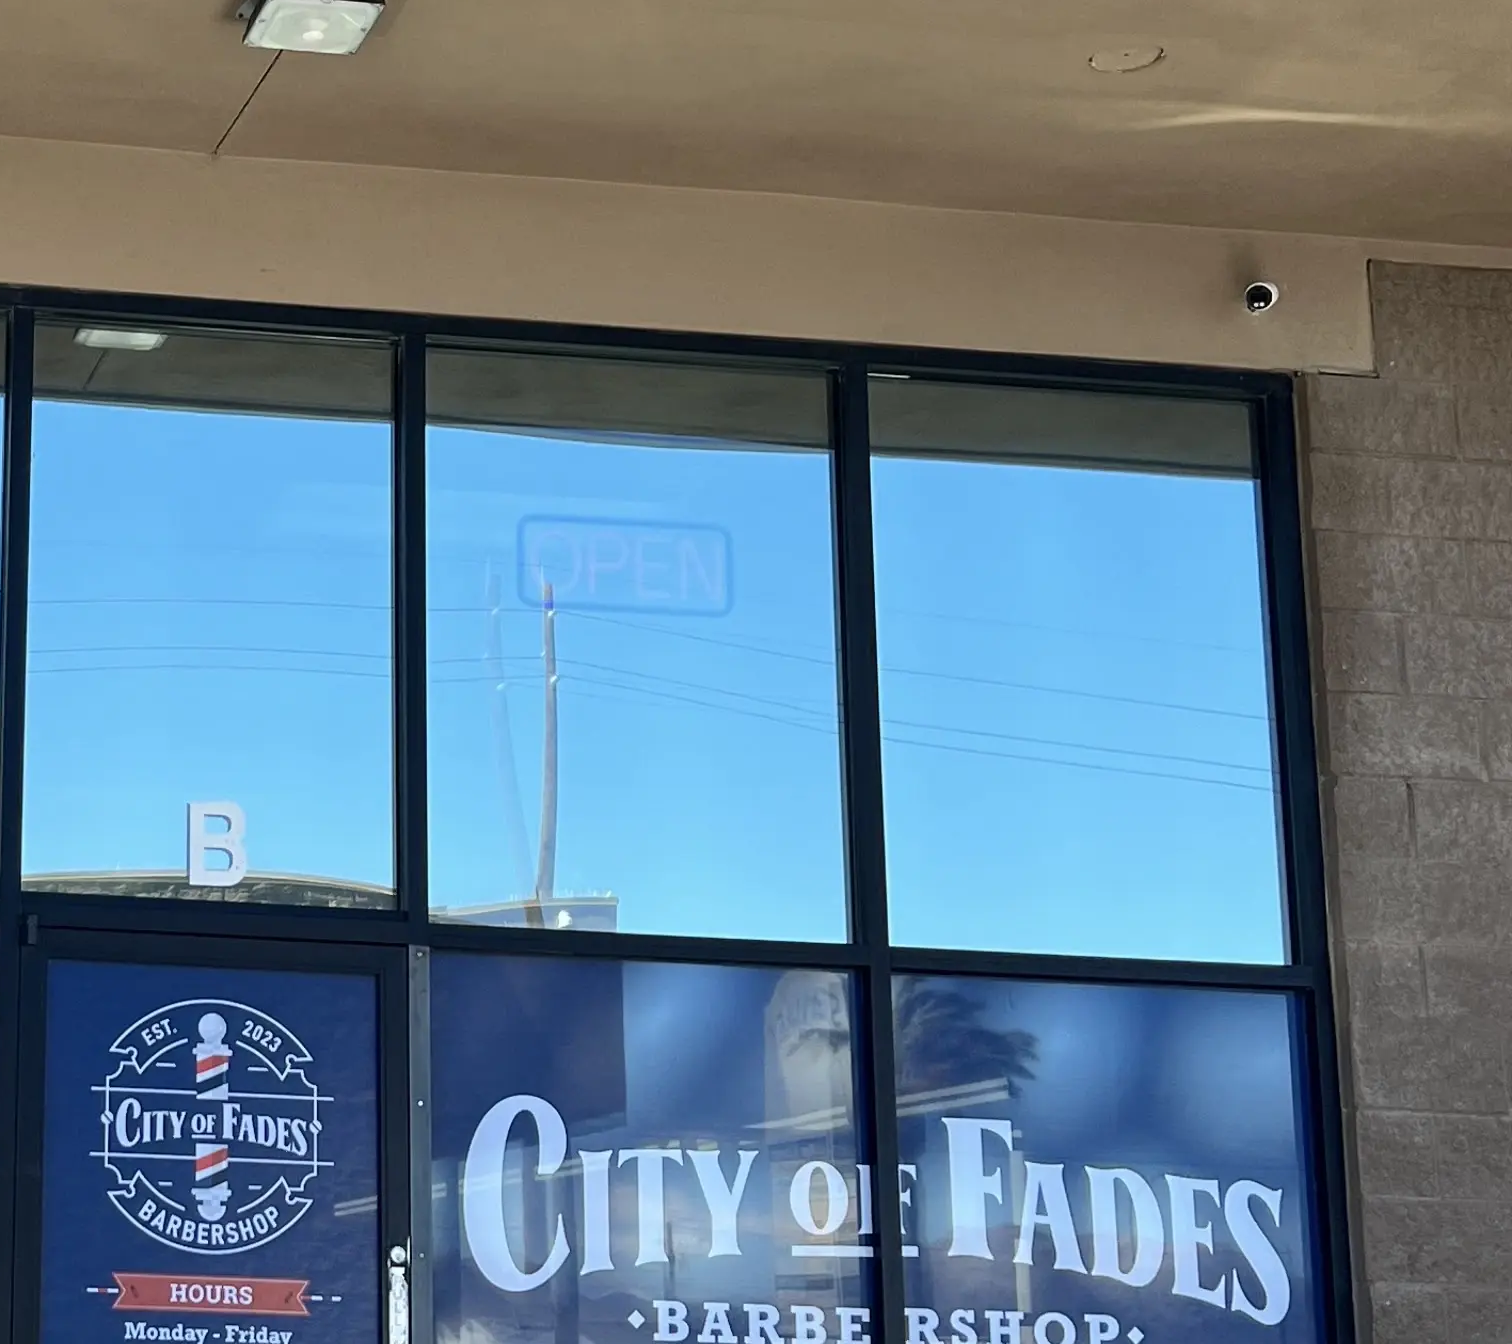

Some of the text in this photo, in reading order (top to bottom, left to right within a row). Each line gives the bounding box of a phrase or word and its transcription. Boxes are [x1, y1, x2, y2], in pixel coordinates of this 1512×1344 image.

[529, 528, 725, 603] OPEN
[187, 800, 248, 887] B
[140, 1017, 282, 1053] EST. 2023
[114, 1096, 188, 1149] CITY
[221, 1101, 309, 1157] FADES
[138, 1199, 281, 1246] BARBERSHOP
[462, 1093, 760, 1293] CITY
[940, 1116, 1291, 1327] FADES
[170, 1283, 253, 1305] HOURS
